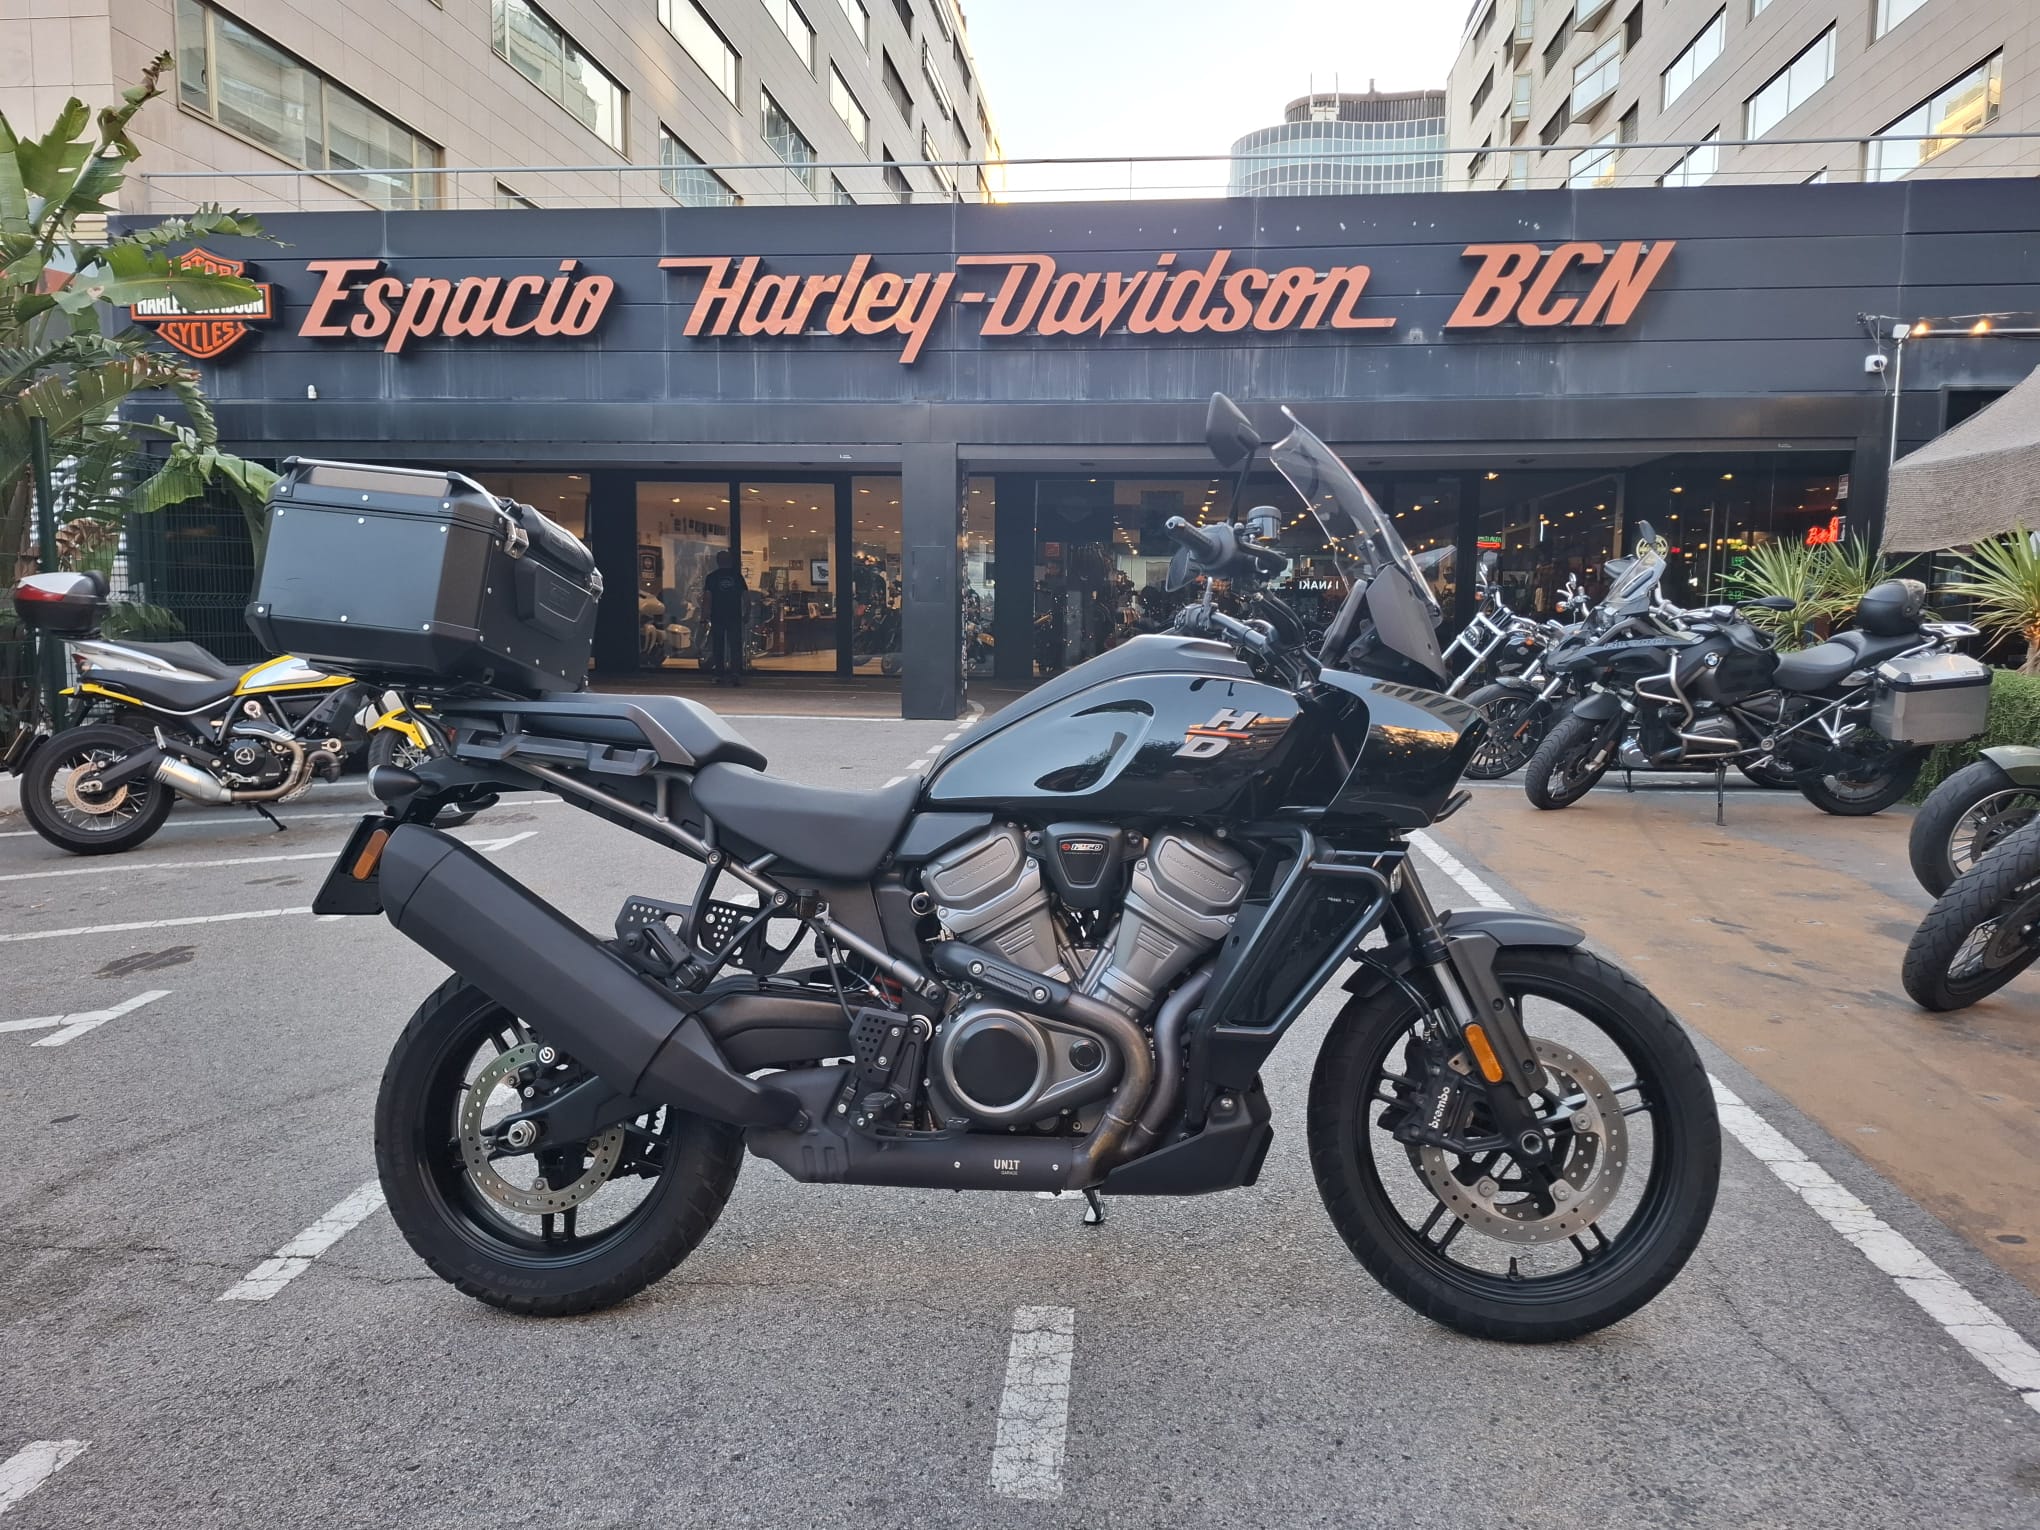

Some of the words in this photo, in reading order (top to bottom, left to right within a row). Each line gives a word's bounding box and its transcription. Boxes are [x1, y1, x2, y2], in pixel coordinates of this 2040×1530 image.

[299, 259, 614, 353] Espacio
[659, 249, 1396, 363] Harley-Davidson
[1447, 241, 1674, 327] BCN
[167, 322, 236, 352] CYCLES
[1205, 708, 1260, 730] H
[1172, 736, 1231, 758] D
[1428, 1086, 1450, 1129] brembo
